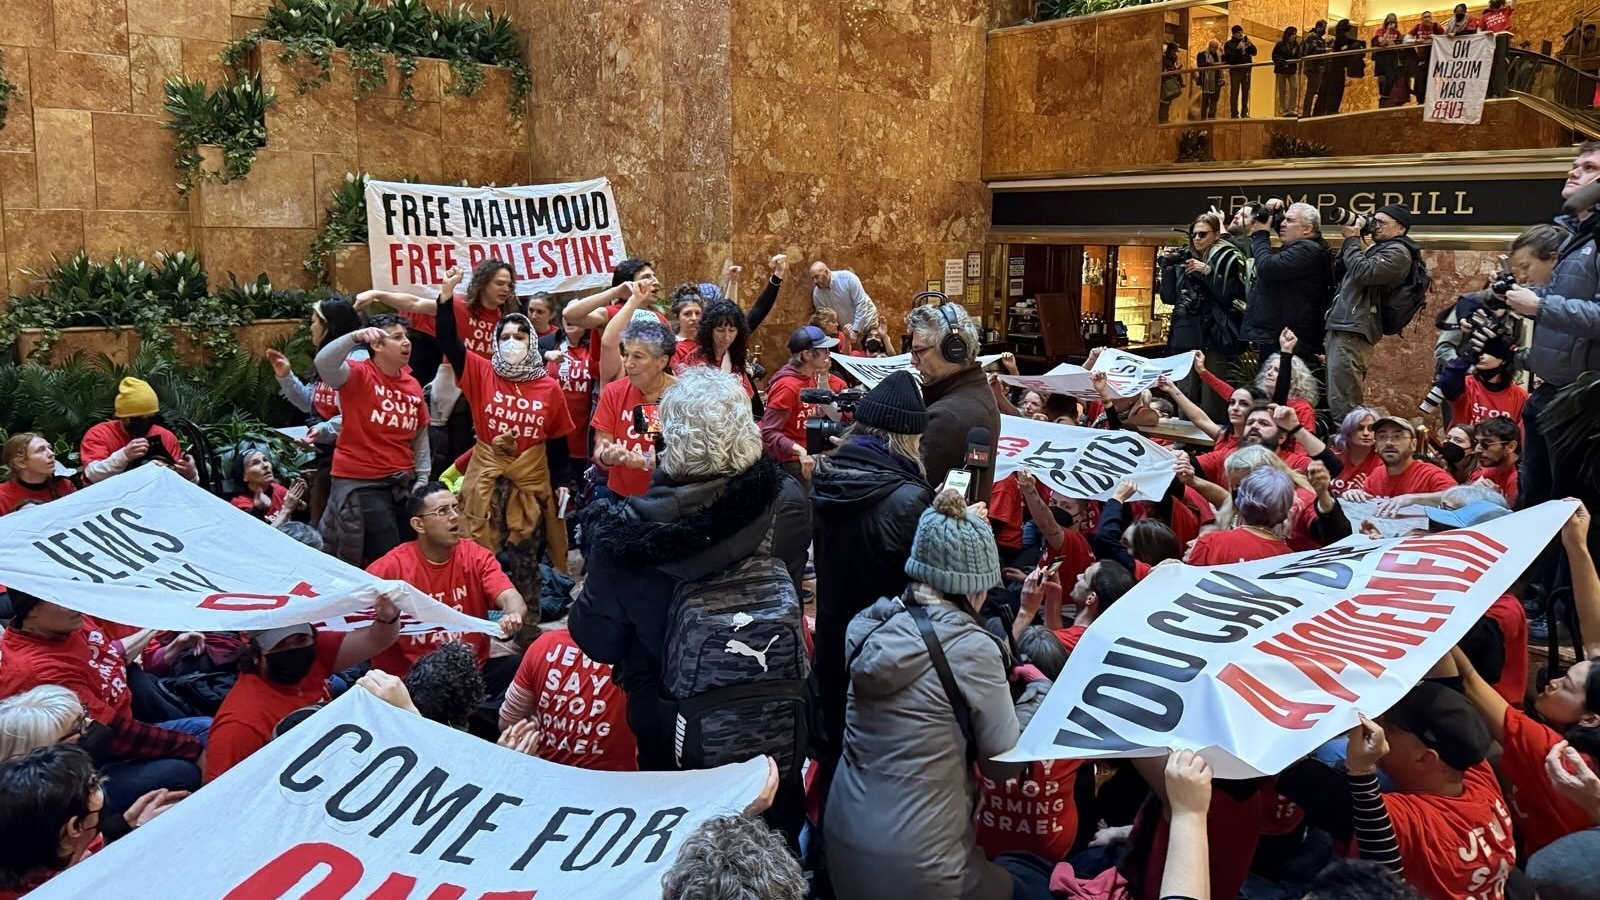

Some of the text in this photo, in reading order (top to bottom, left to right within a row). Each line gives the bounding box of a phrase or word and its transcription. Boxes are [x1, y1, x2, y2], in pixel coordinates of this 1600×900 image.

[383, 191, 609, 238] FREE MAHMOUD
[1207, 193, 1336, 216] TRMP
[389, 235, 617, 286] FREE PLESTINE
[469, 317, 493, 330] NOT
[464, 338, 493, 354] NA
[474, 329, 493, 342] OU
[559, 368, 591, 380] UR
[374, 385, 402, 400] NOT
[561, 380, 587, 392] AM
[381, 399, 418, 416] OUR
[493, 390, 543, 412] STOP
[484, 403, 545, 426] ARMING
[453, 585, 467, 602] IN
[545, 643, 615, 670] JEW
[545, 668, 610, 696] SAY
[538, 690, 607, 717] STOP
[1053, 637, 1207, 752] YOU
[1216, 662, 1337, 730] A
[542, 712, 611, 738] RMING
[278, 723, 524, 865] COME
[509, 806, 689, 872] FOR
